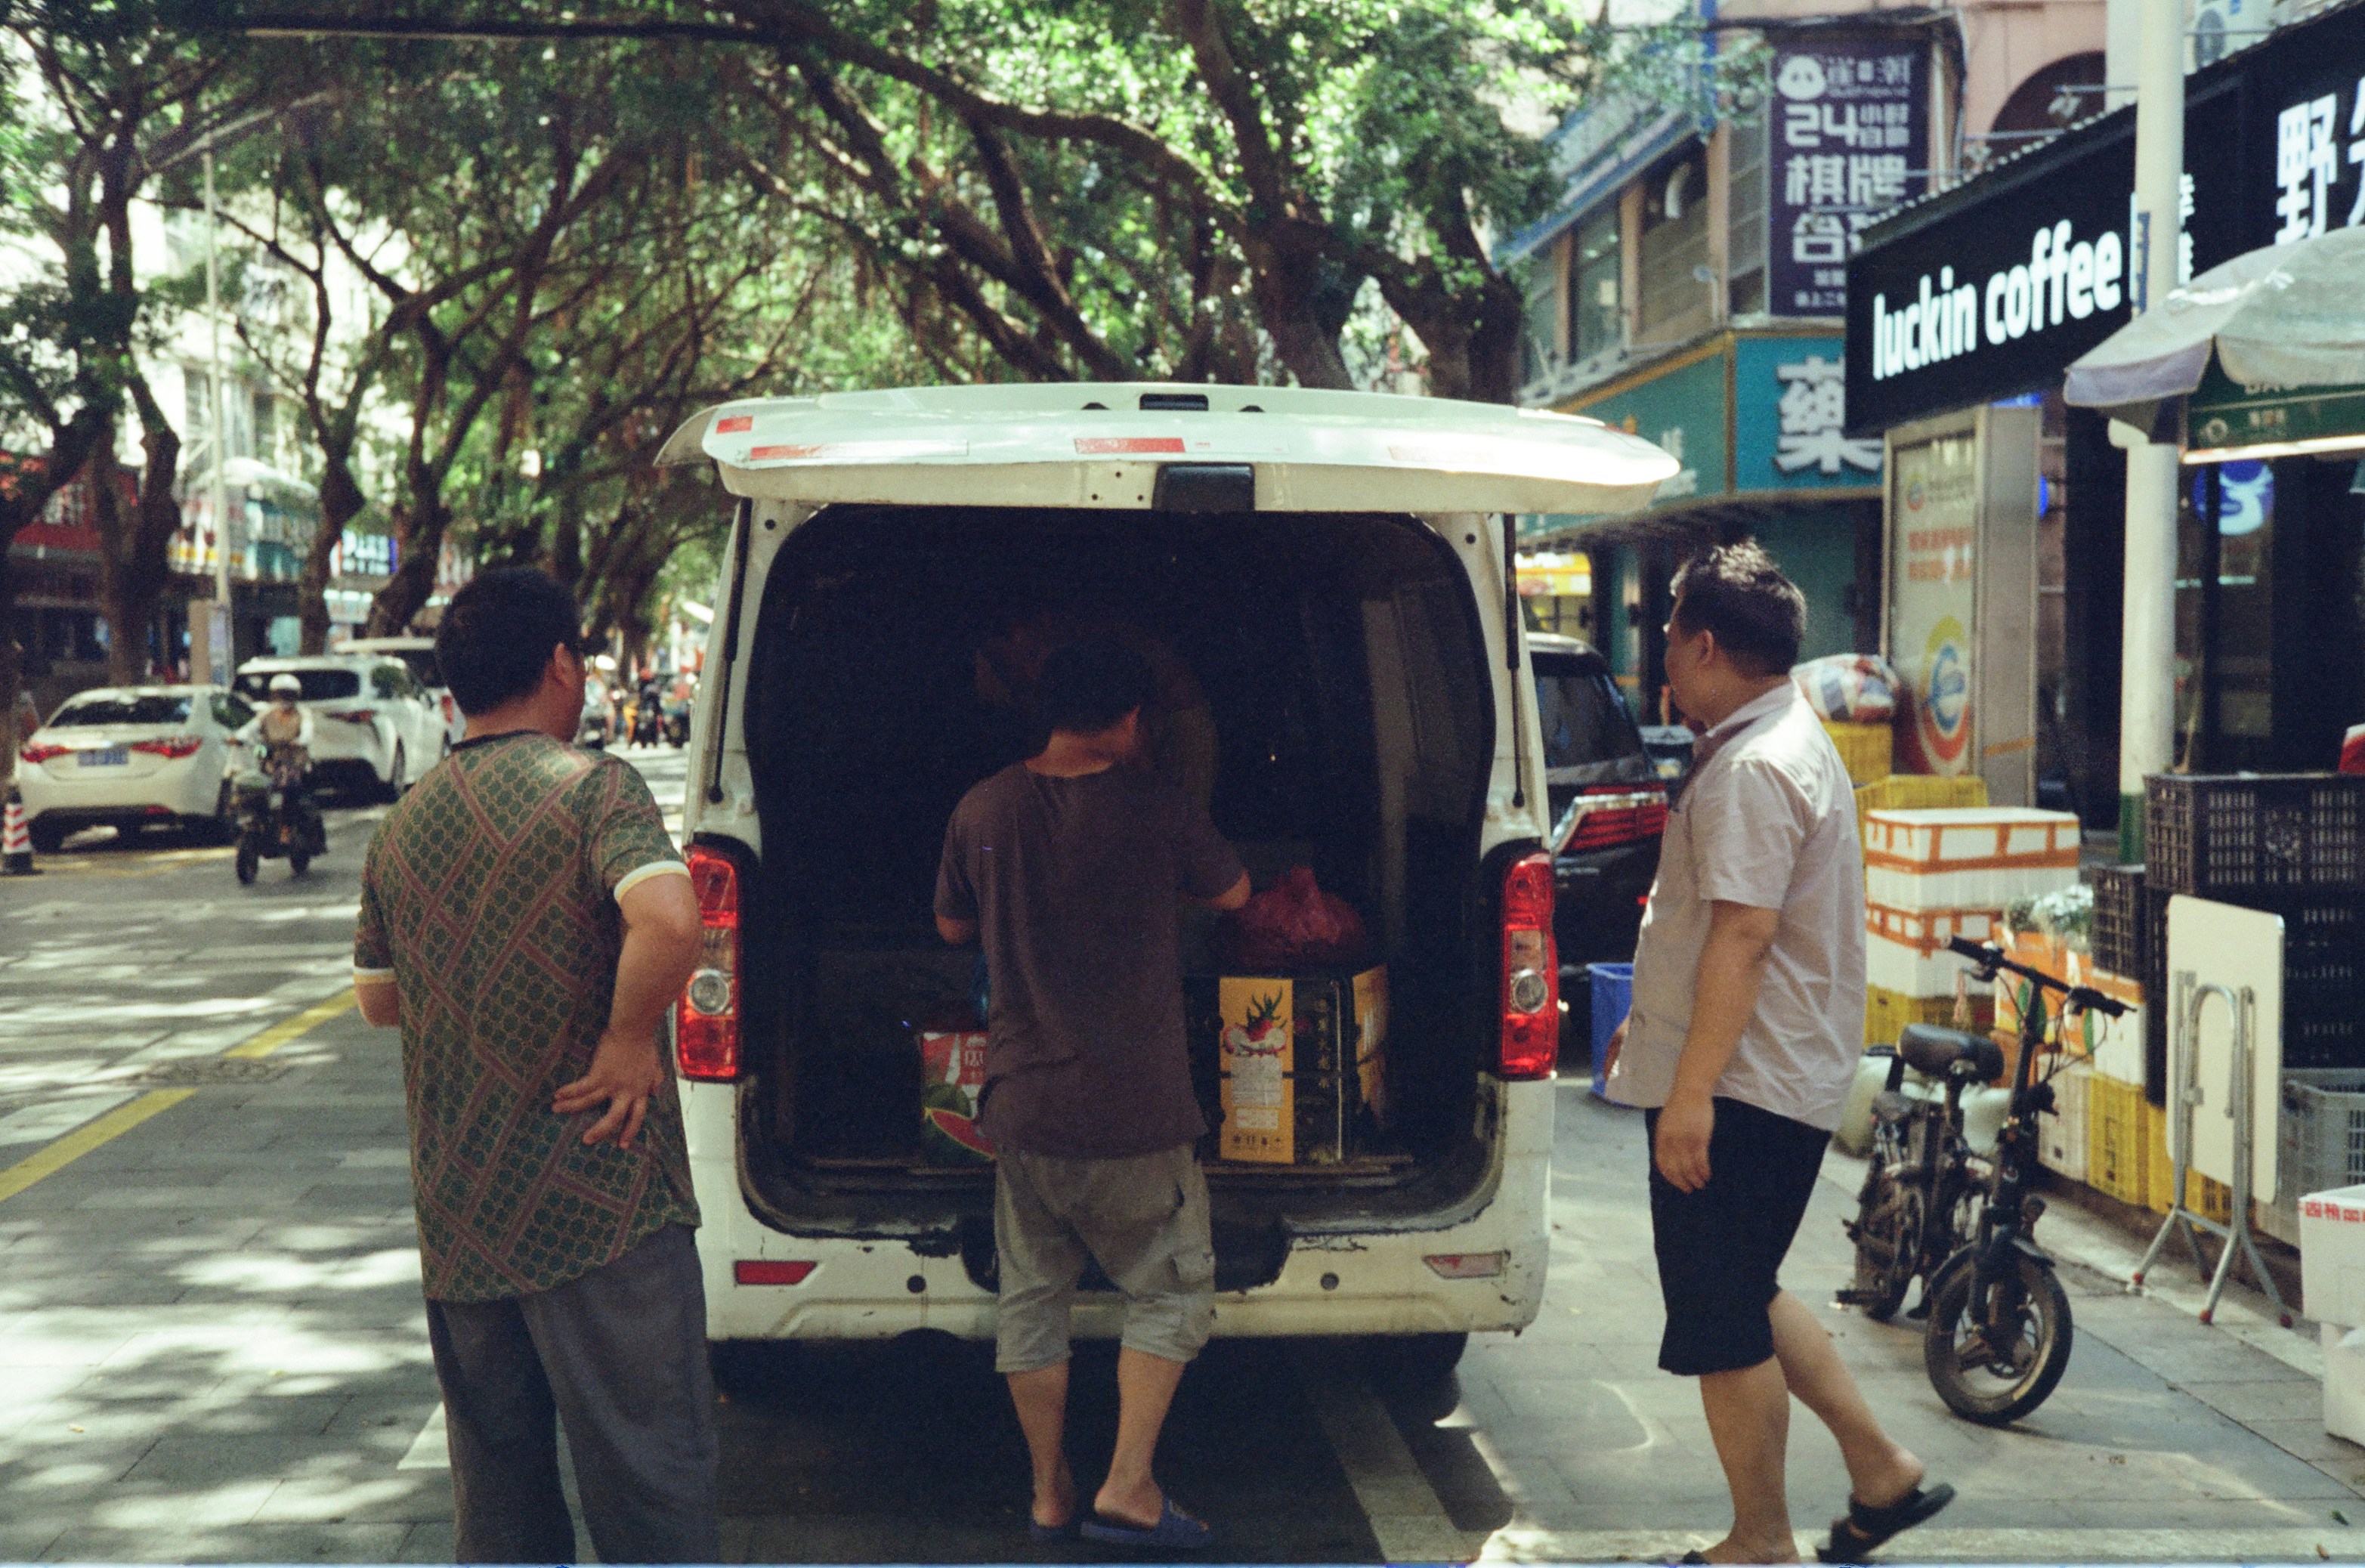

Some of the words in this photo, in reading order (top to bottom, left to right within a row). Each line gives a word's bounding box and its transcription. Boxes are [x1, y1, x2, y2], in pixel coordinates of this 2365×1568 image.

[1785, 104, 1858, 147] 24
[1785, 153, 1907, 206] 棋牌
[2275, 77, 2365, 245] 野
[1792, 212, 1863, 262] 台
[1872, 264, 1977, 381] luckin
[1985, 219, 2122, 345] coffee
